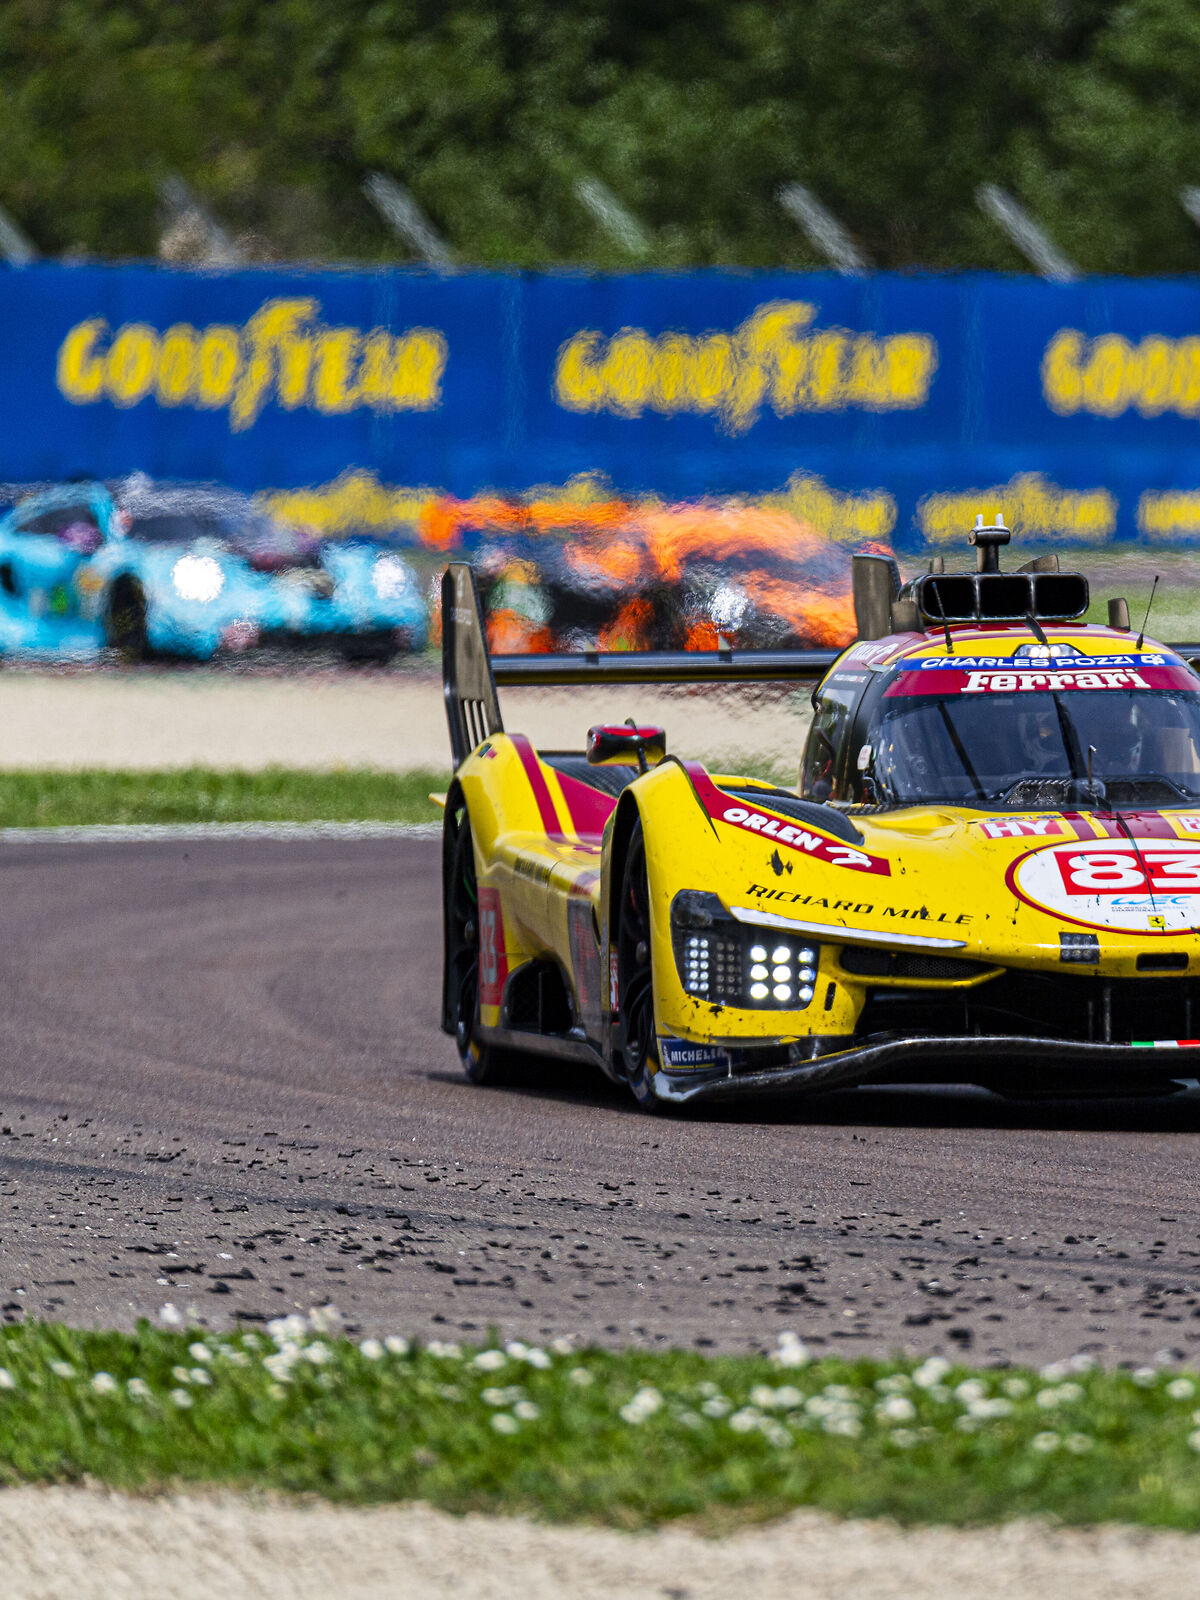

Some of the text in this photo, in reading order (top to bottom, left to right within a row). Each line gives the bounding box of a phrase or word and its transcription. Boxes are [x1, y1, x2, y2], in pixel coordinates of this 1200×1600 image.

[920, 655, 1135, 669] CHARLES POZZI
[960, 668, 1152, 694] Ferrari
[723, 807, 824, 851] ORLEN
[745, 883, 975, 925] RICHARD MILLE
